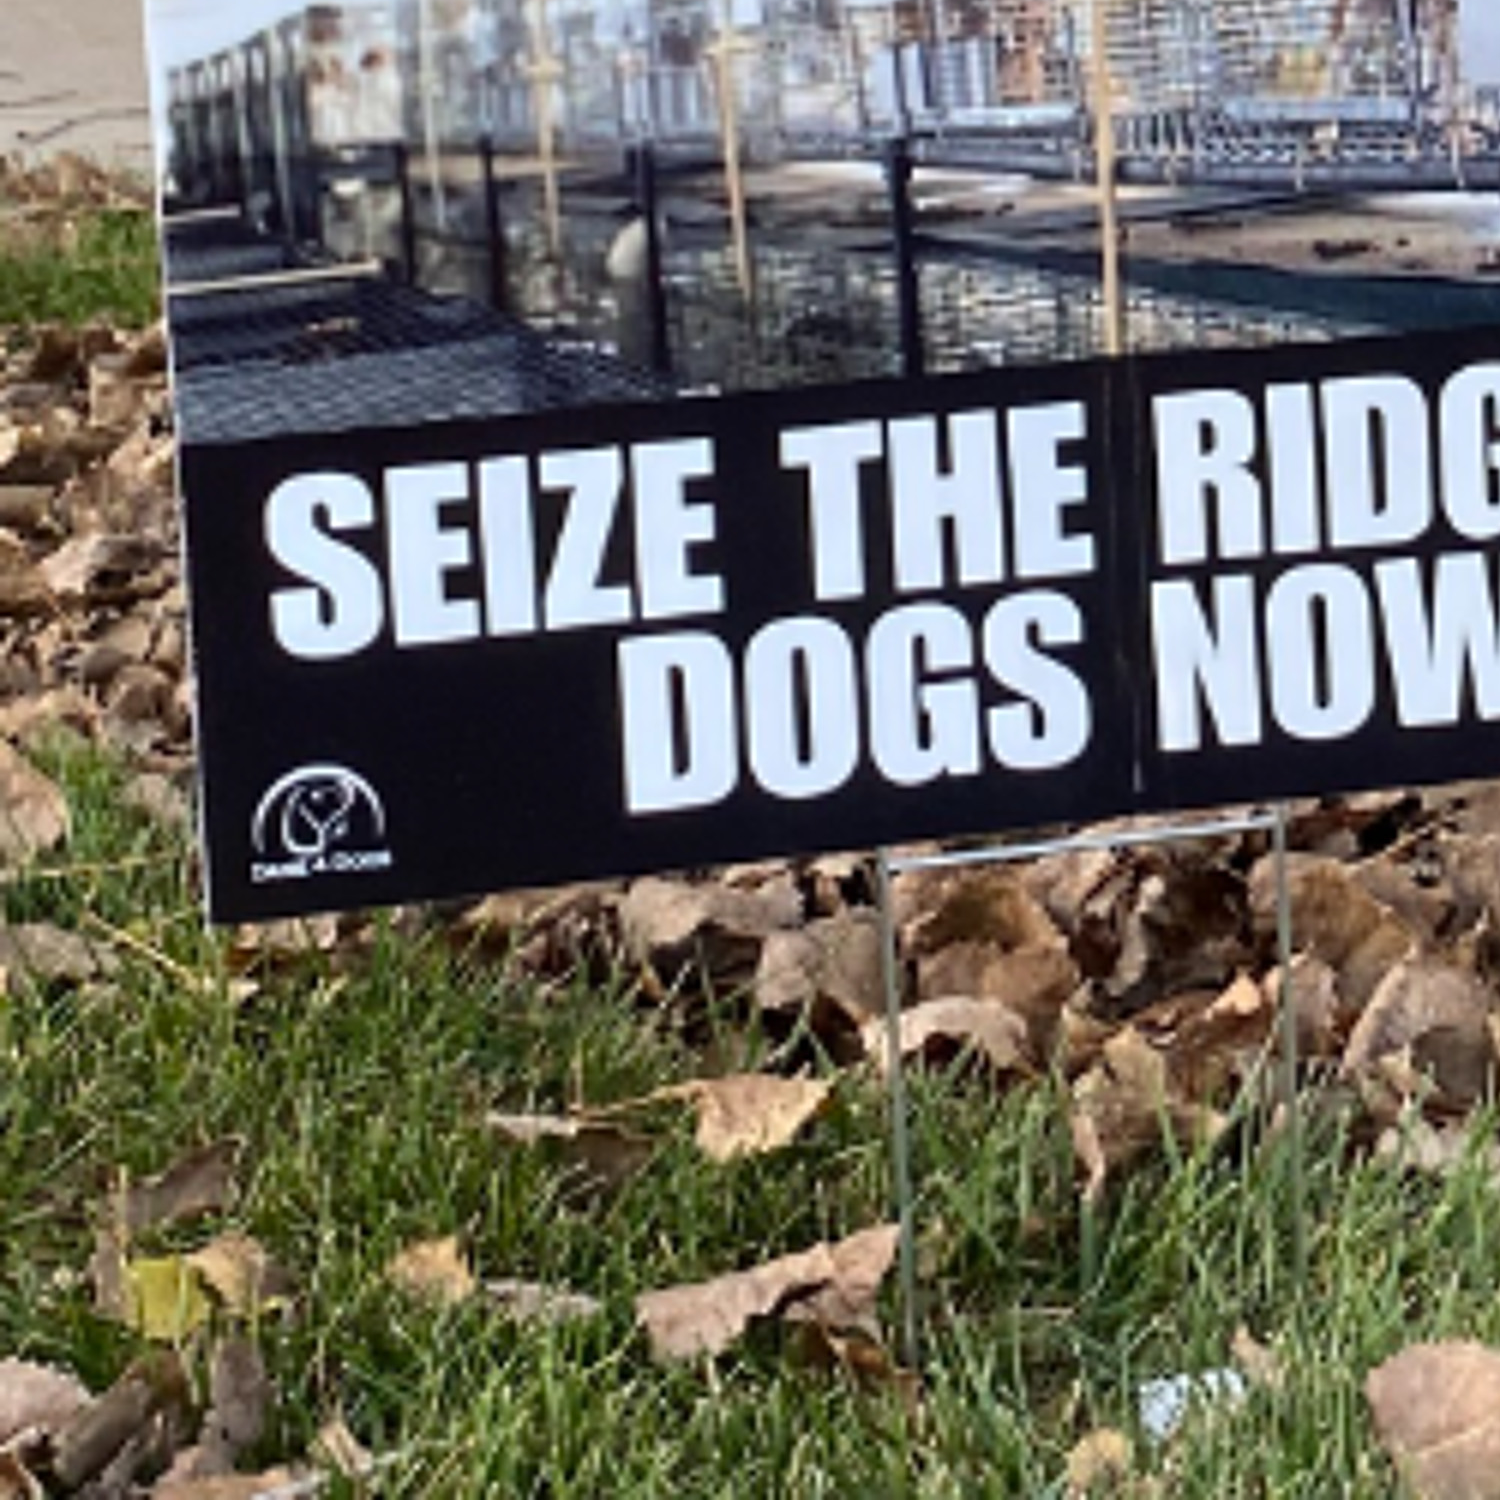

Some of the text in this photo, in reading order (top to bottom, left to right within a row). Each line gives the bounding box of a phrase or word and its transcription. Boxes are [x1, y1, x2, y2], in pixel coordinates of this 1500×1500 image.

[264, 436, 725, 660] SEIZE
[779, 399, 1095, 602] THE
[617, 589, 1092, 815] DOGS
